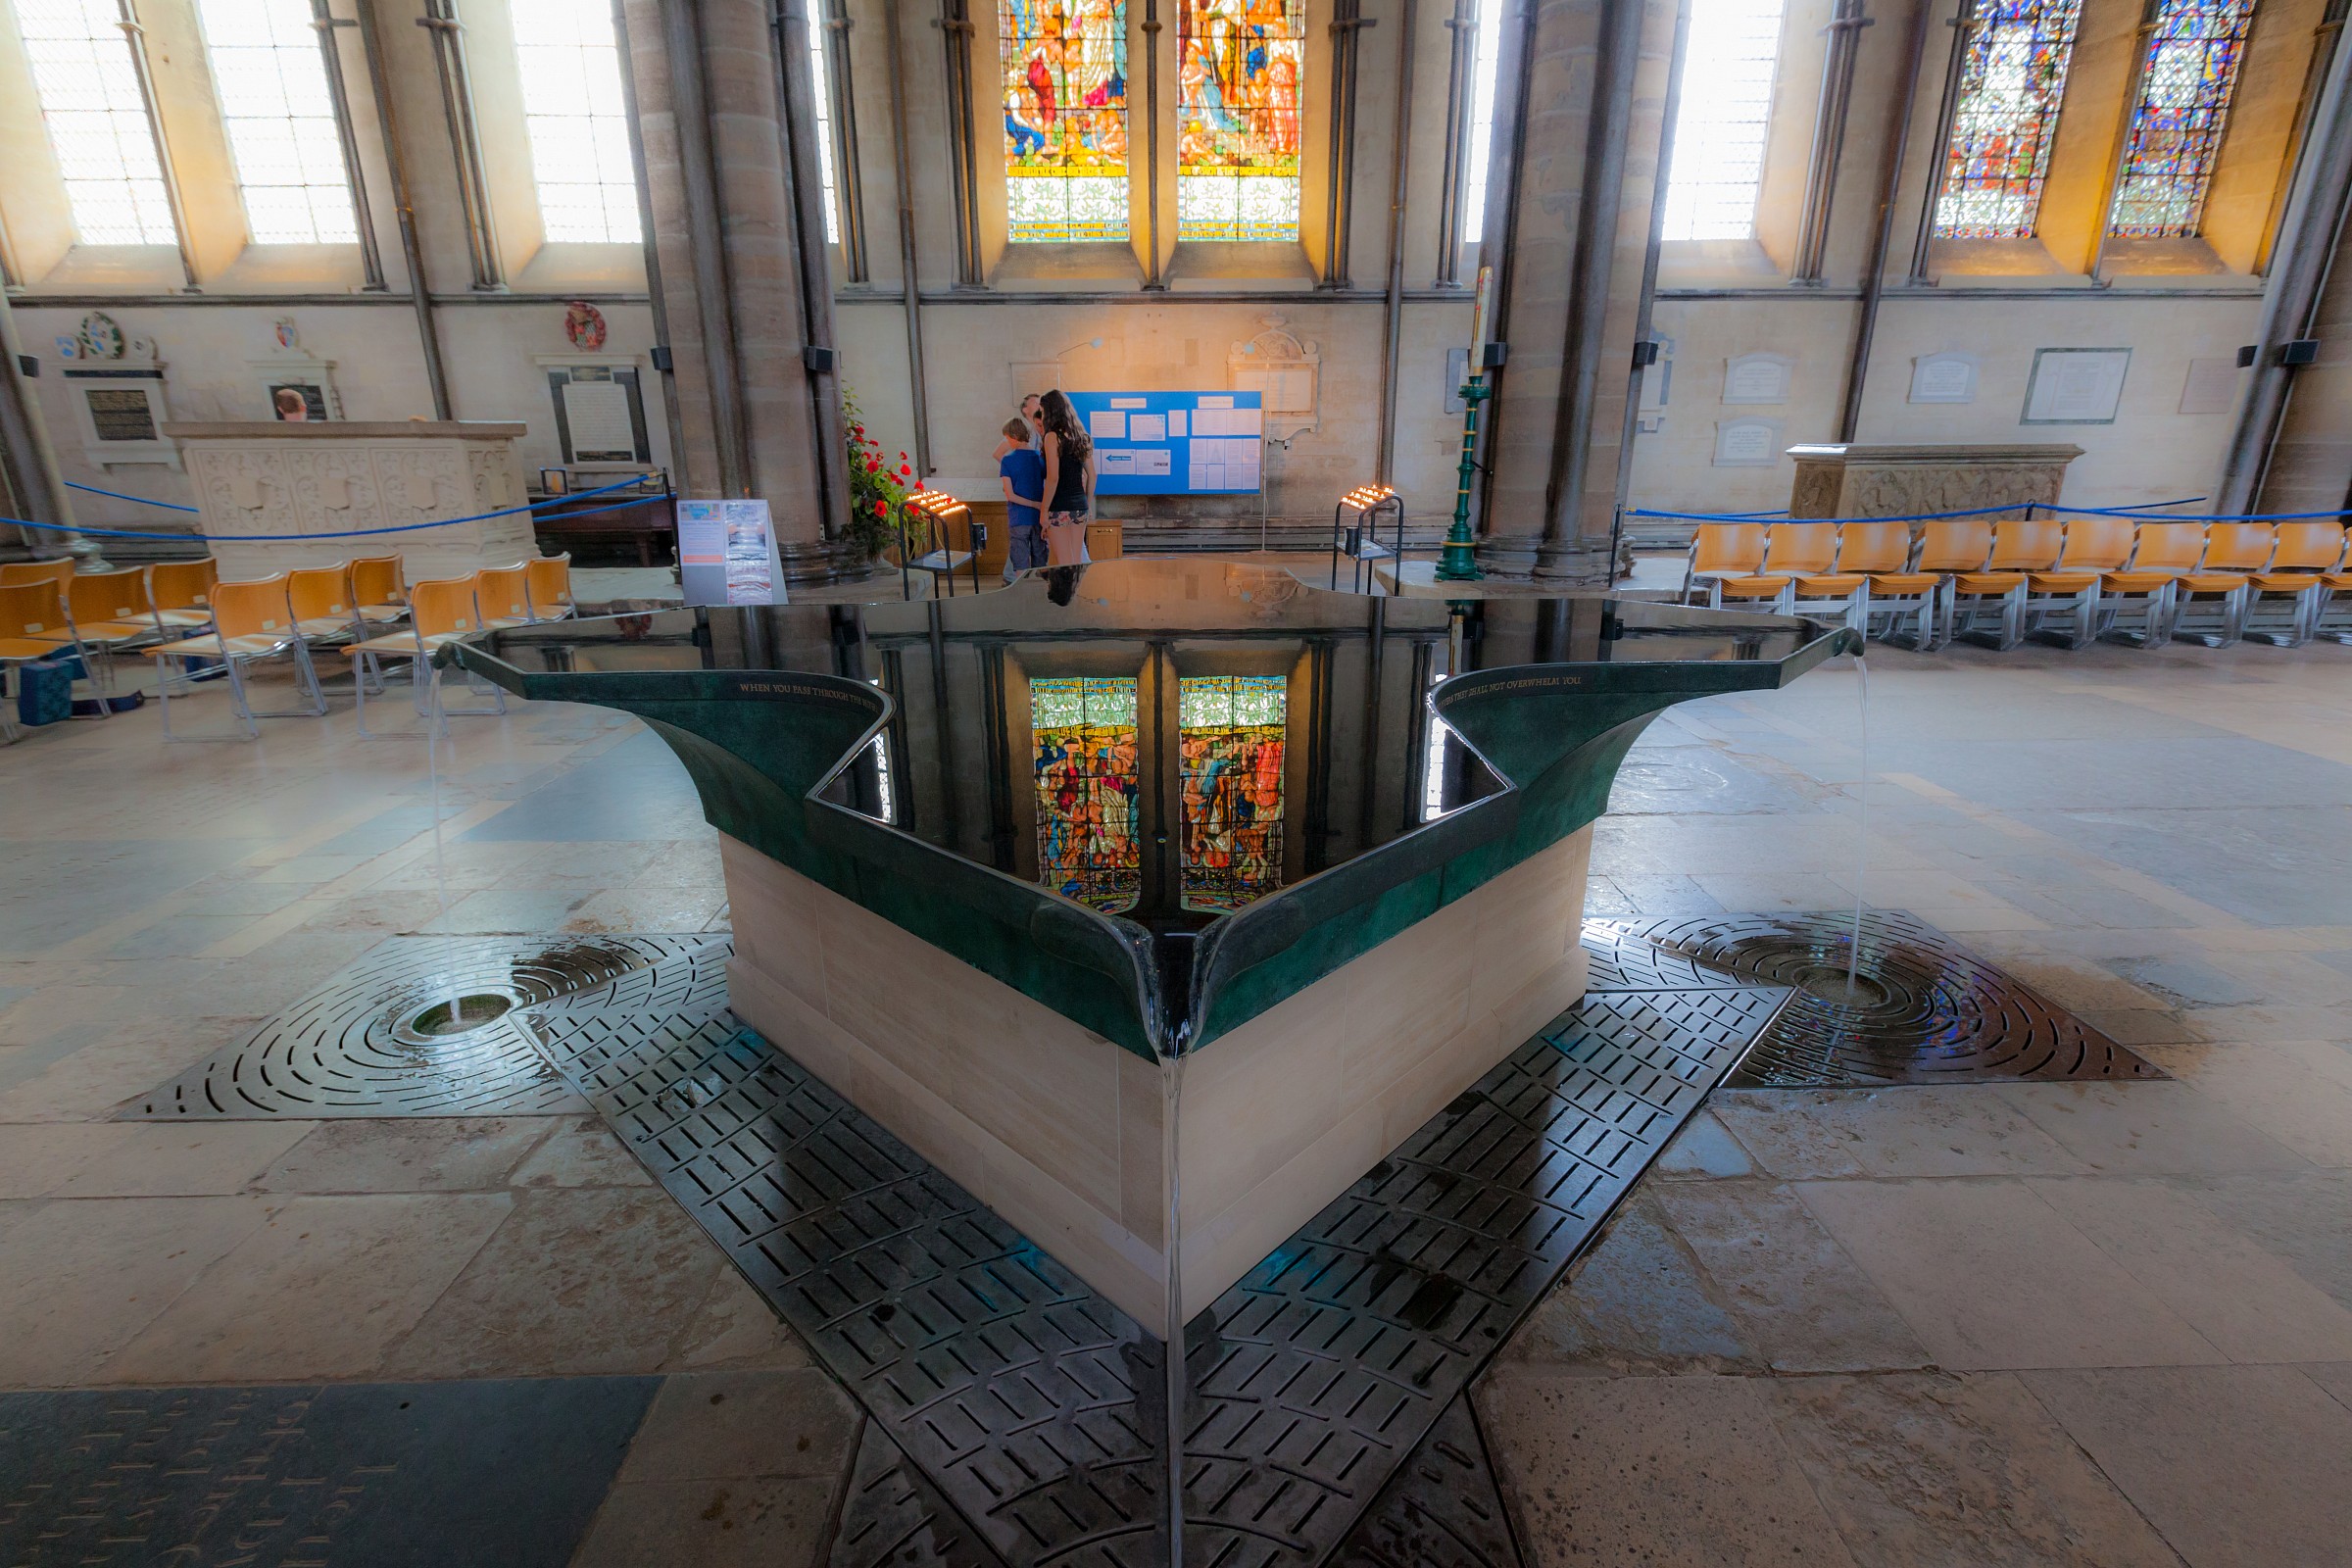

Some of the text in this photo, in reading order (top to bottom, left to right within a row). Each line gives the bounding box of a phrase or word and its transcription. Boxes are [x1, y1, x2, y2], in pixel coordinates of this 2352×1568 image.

[740, 683, 770, 692] WHEN
[772, 684, 791, 693] YOU
[793, 685, 811, 695] PASS
[811, 687, 849, 702] THROUGH
[1468, 684, 1488, 697] SHALL
[1489, 681, 1505, 692] NOT
[1506, 677, 1559, 689] OVERWHELM
